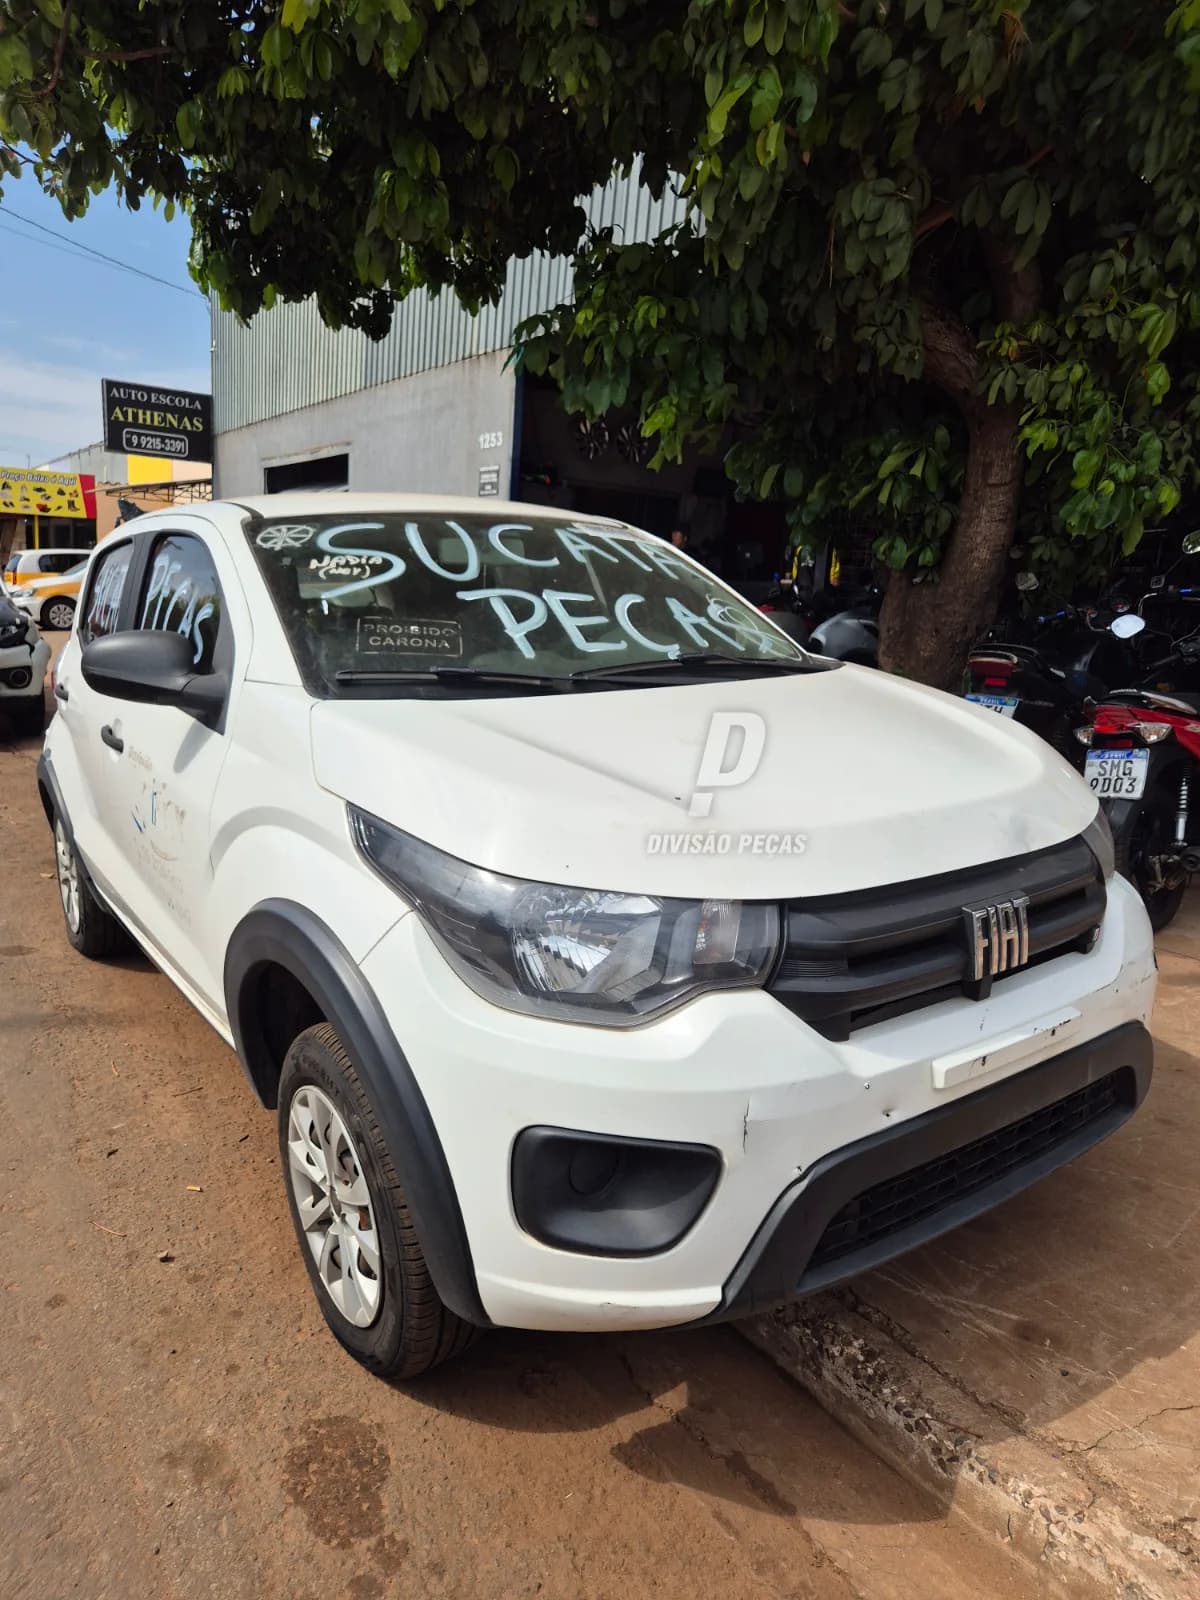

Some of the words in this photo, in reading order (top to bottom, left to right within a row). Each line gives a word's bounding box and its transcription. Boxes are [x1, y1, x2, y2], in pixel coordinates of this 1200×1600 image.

[110, 387, 148, 402] AUTO
[151, 392, 202, 410] ESCOLA
[111, 405, 204, 432] ATHENAS
[131, 434, 138, 448] 9
[479, 431, 503, 449] 1253
[316, 520, 715, 614] SUCATA
[363, 623, 458, 637] PROIBIDO
[368, 636, 451, 650] CARONA
[1098, 760, 1134, 777] SMG
[972, 896, 1030, 981] FIAT
